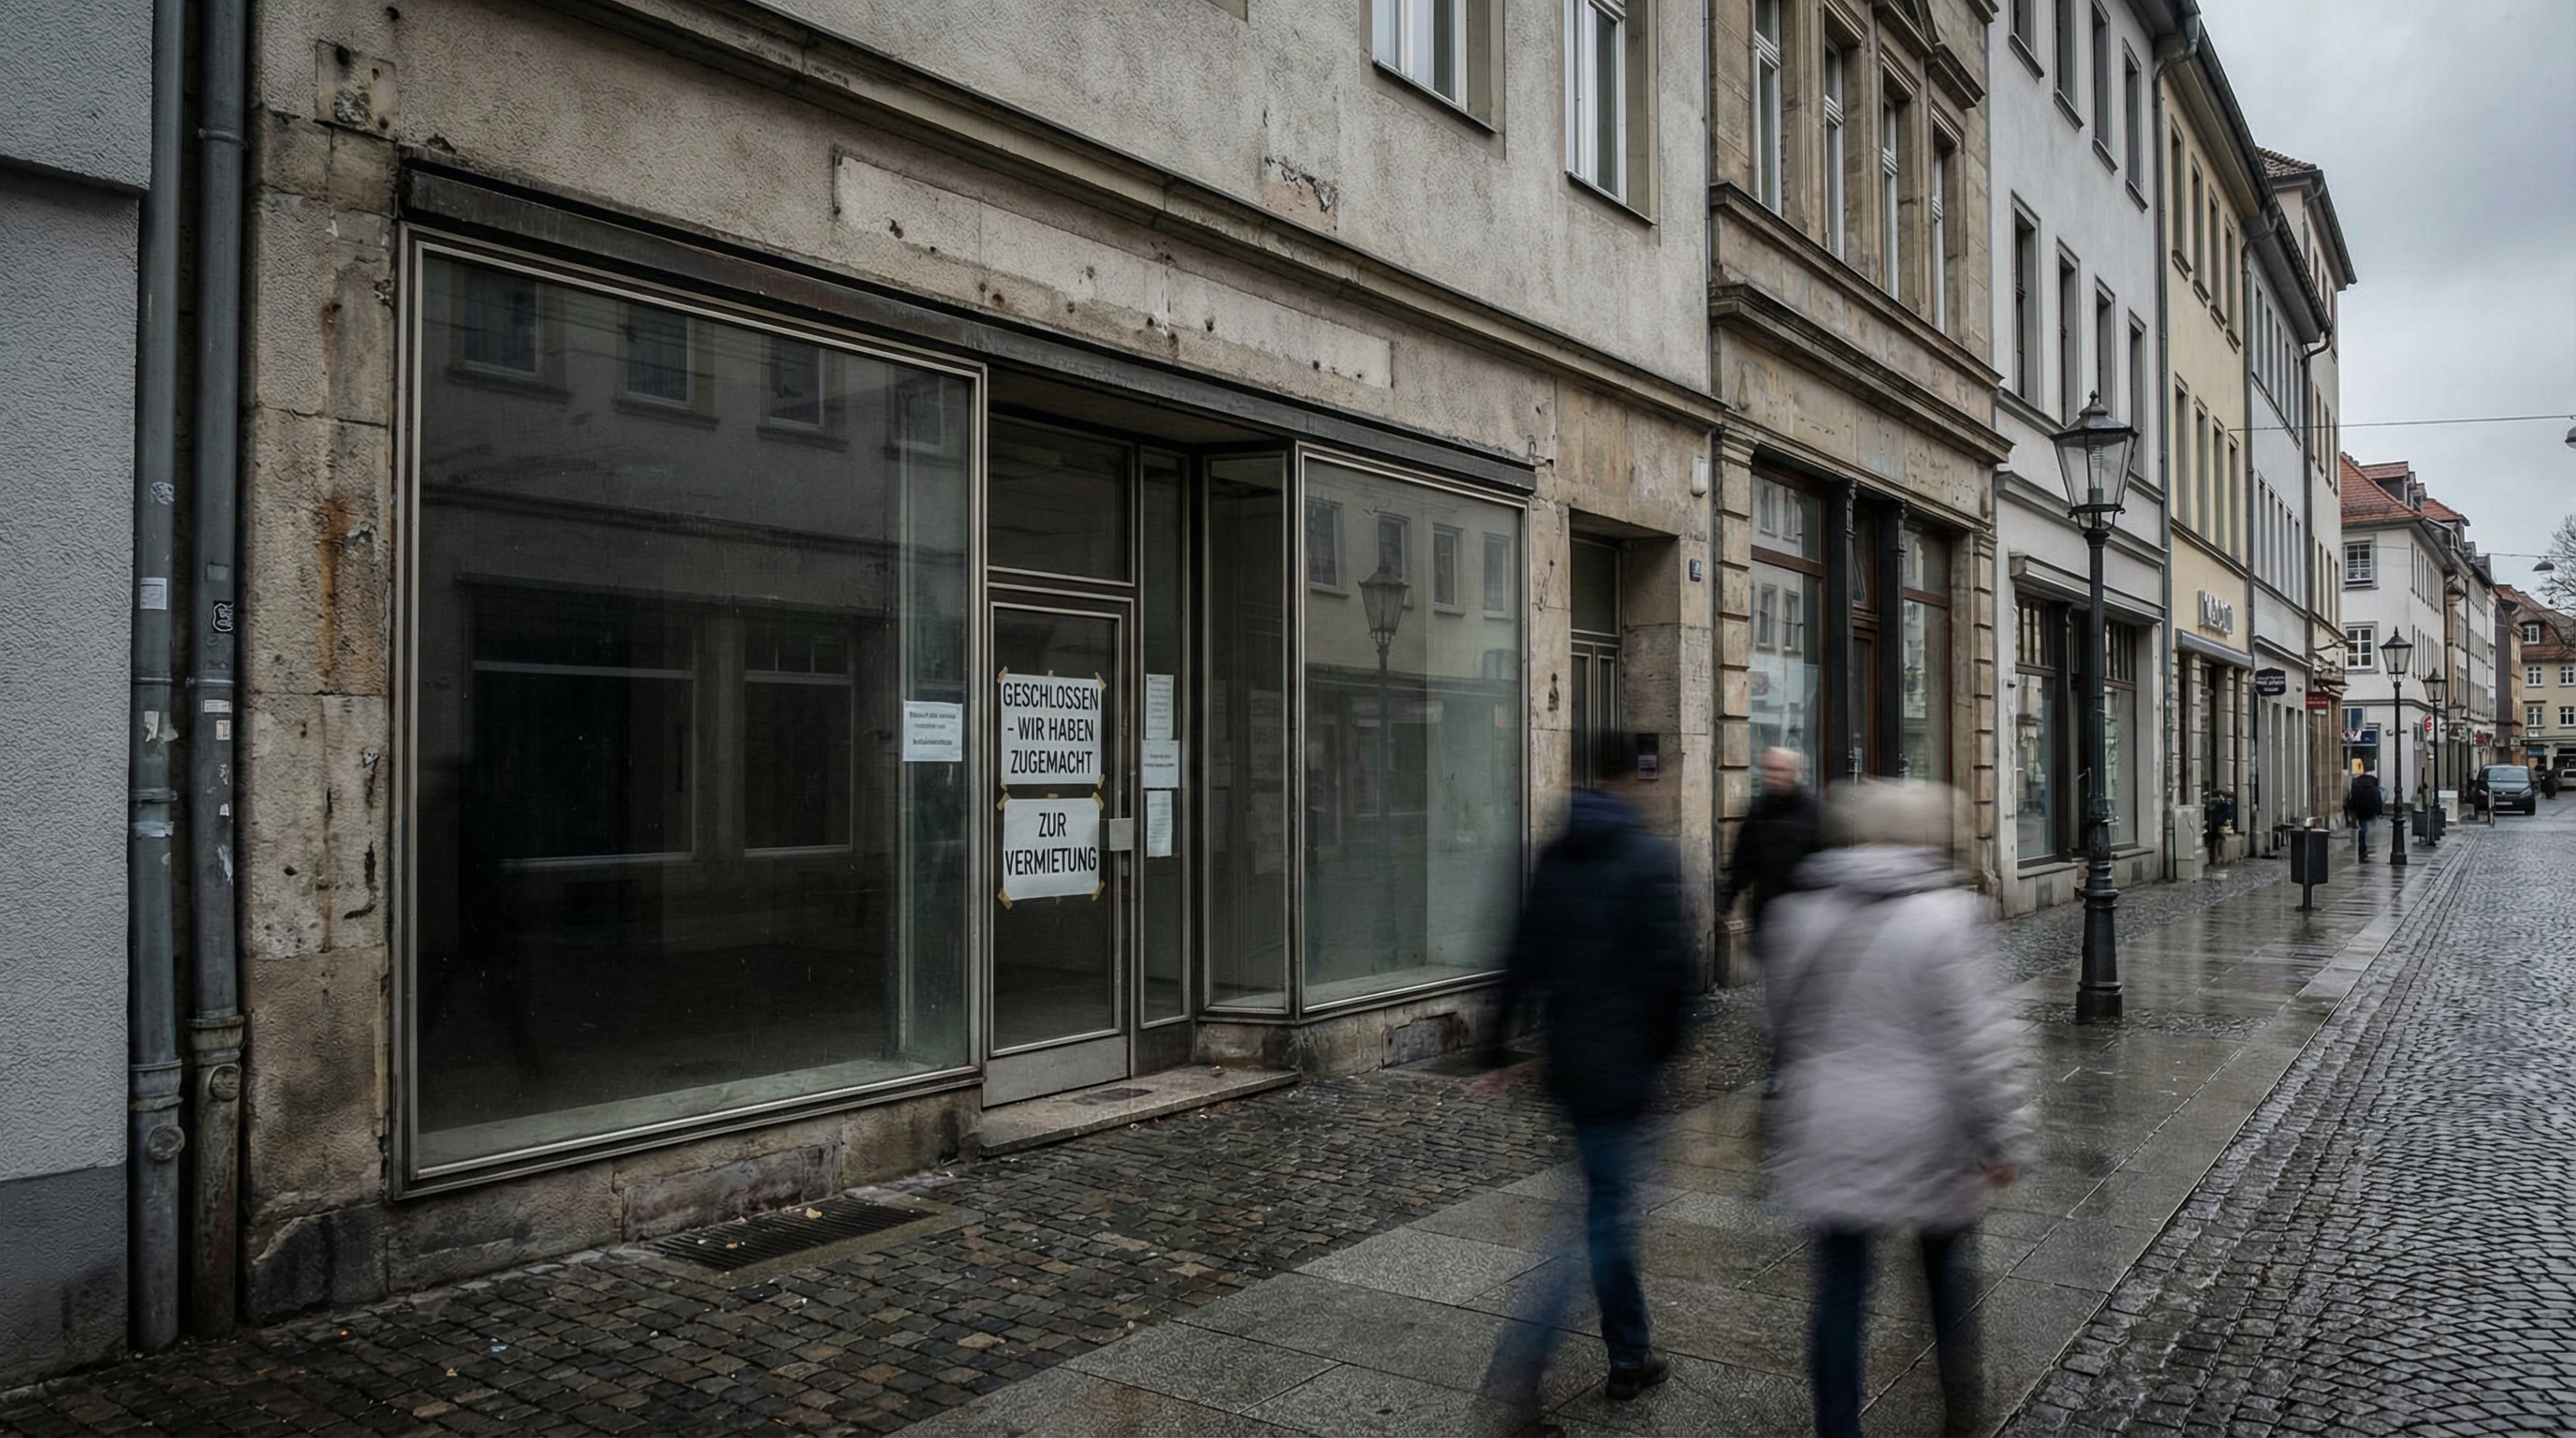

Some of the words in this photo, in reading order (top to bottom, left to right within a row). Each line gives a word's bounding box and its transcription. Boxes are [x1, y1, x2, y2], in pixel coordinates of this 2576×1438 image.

[1003, 682, 1099, 711] GESCHLOSSEN
[1017, 716, 1045, 741] WIR
[1048, 718, 1094, 742] HABEN
[1010, 750, 1093, 774] ZUGEMACHT
[1038, 812, 1067, 838] ZUR
[1004, 846, 1097, 876] VERMIETUNG
